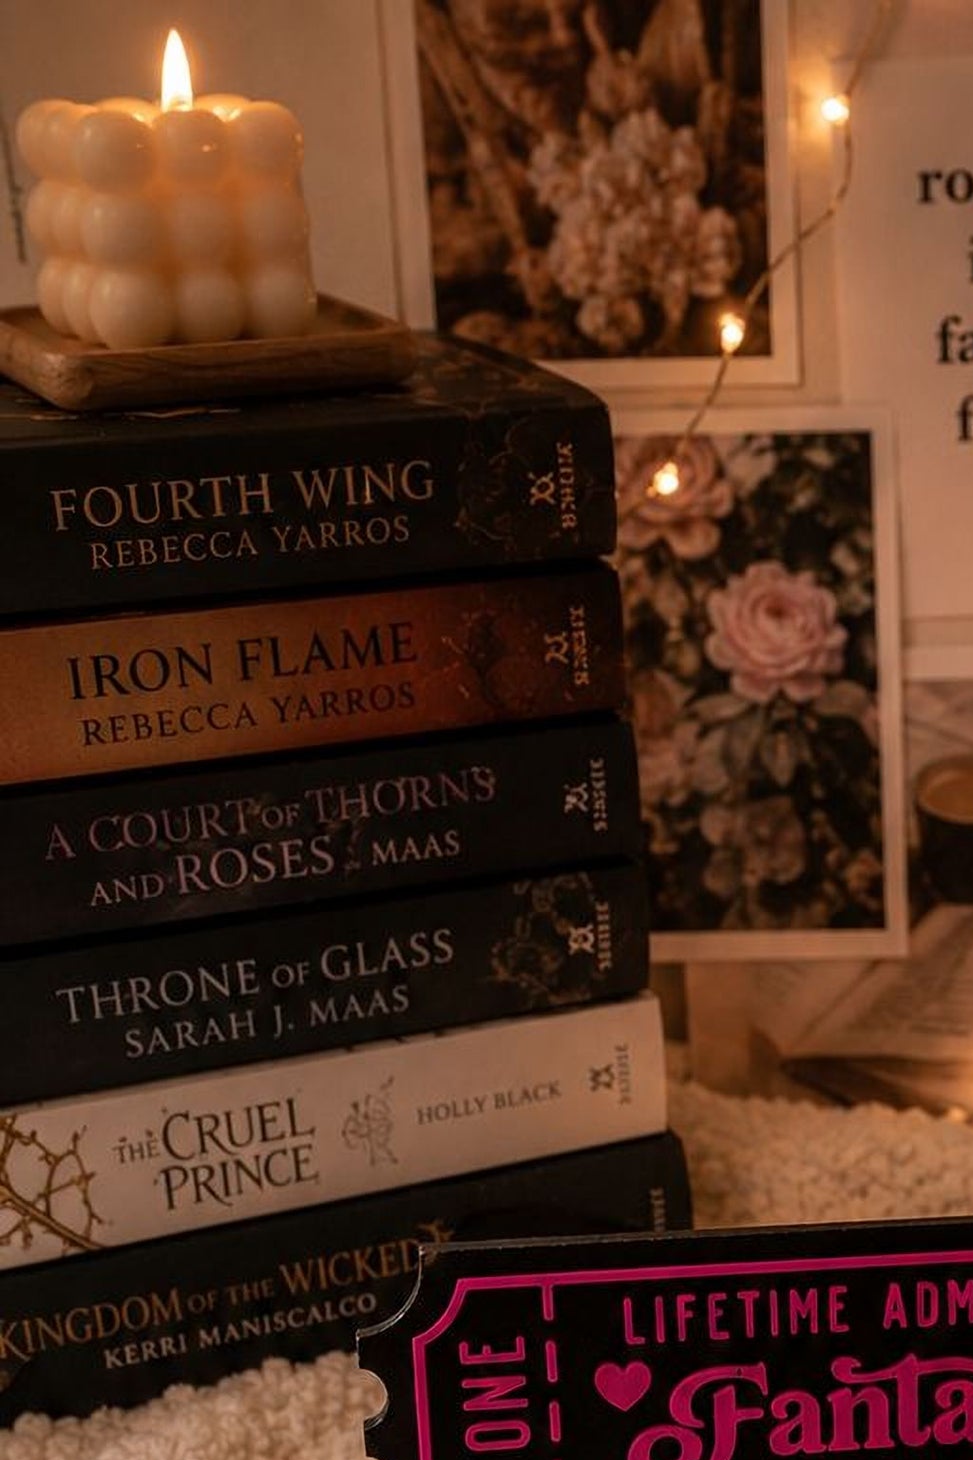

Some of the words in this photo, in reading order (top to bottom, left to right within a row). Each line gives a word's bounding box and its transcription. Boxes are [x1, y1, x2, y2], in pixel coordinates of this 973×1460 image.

[49, 472, 273, 533] FOURTH
[291, 459, 436, 510] WING
[90, 531, 259, 571] REBECCA
[271, 515, 411, 554] YARROS
[66, 642, 213, 701] IRON
[237, 622, 420, 682] FLAME
[80, 701, 258, 747] REBECCA
[271, 681, 418, 725] YARROS
[44, 822, 77, 862] A
[87, 797, 254, 853] COURT
[261, 803, 301, 829] OF
[303, 765, 497, 824] THORNS
[90, 872, 165, 907] AND
[175, 835, 334, 896] ROSES
[371, 829, 462, 867] MAAS
[56, 959, 260, 1026] THRONE
[271, 962, 311, 989] OF
[320, 928, 455, 982] GLASS
[125, 1015, 257, 1059] SARAH
[272, 1006, 295, 1038] J.
[309, 985, 411, 1027] MAAS
[113, 1137, 160, 1166] THE
[161, 1098, 316, 1162] CRUEL
[416, 1095, 487, 1125] HOLLY
[494, 1080, 563, 1110] BLACK
[158, 1144, 319, 1210] PRINCE
[0, 1286, 184, 1363] KINGDOM
[187, 1289, 220, 1314] OF
[225, 1279, 276, 1307] THE
[279, 1237, 421, 1295] WICKED
[103, 1333, 188, 1369] KERRI
[199, 1292, 378, 1349] MANISCALCO
[623, 1286, 850, 1348] LIFETIME
[459, 1335, 534, 1454] ONE
